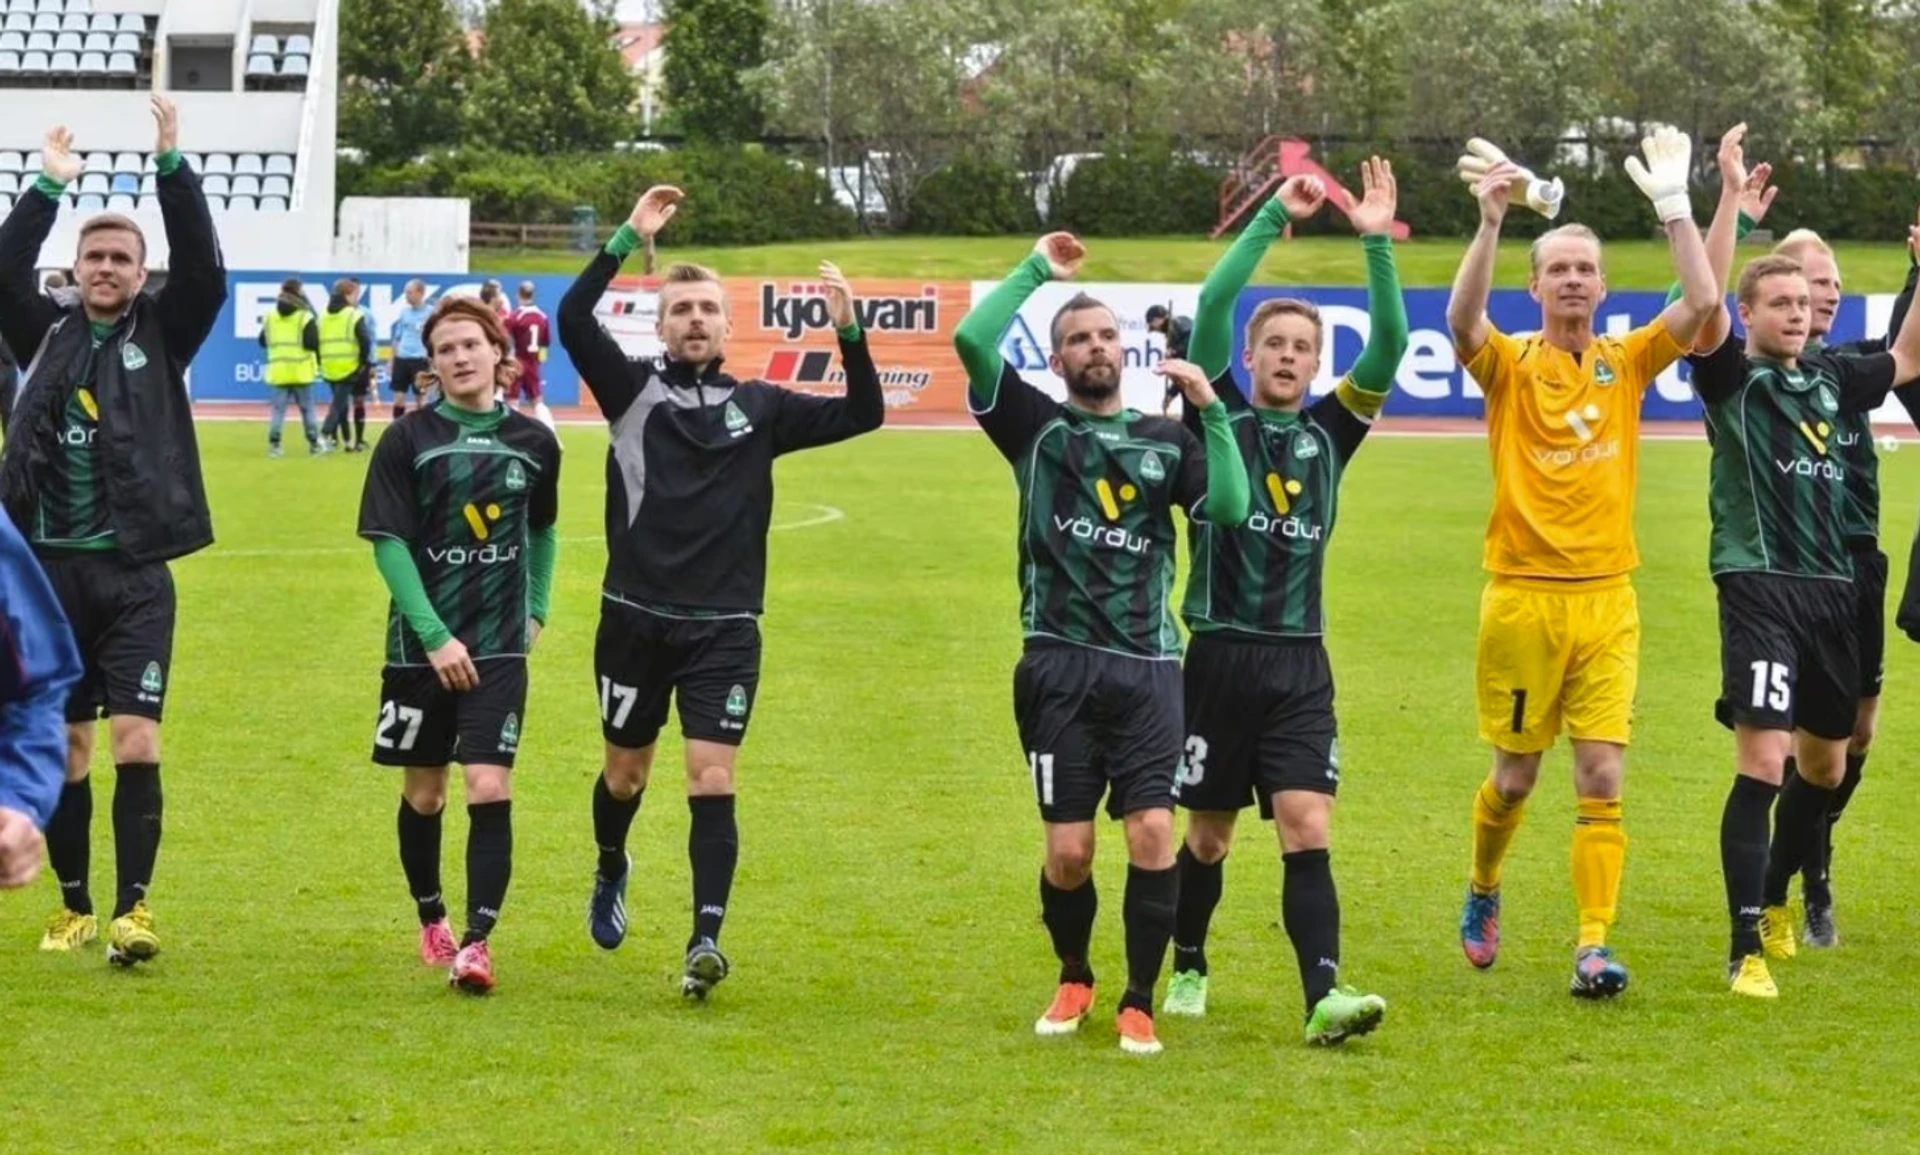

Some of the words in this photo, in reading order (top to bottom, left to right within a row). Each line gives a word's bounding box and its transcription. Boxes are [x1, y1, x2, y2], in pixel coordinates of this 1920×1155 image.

[763, 284, 936, 339] kjövari
[57, 426, 98, 444] vör
[1776, 457, 1844, 480] vörðu
[1248, 511, 1322, 540] örður
[601, 673, 638, 729] 17
[1751, 660, 1790, 711] 15
[375, 699, 423, 750] 27
[1511, 688, 1528, 734] 1
